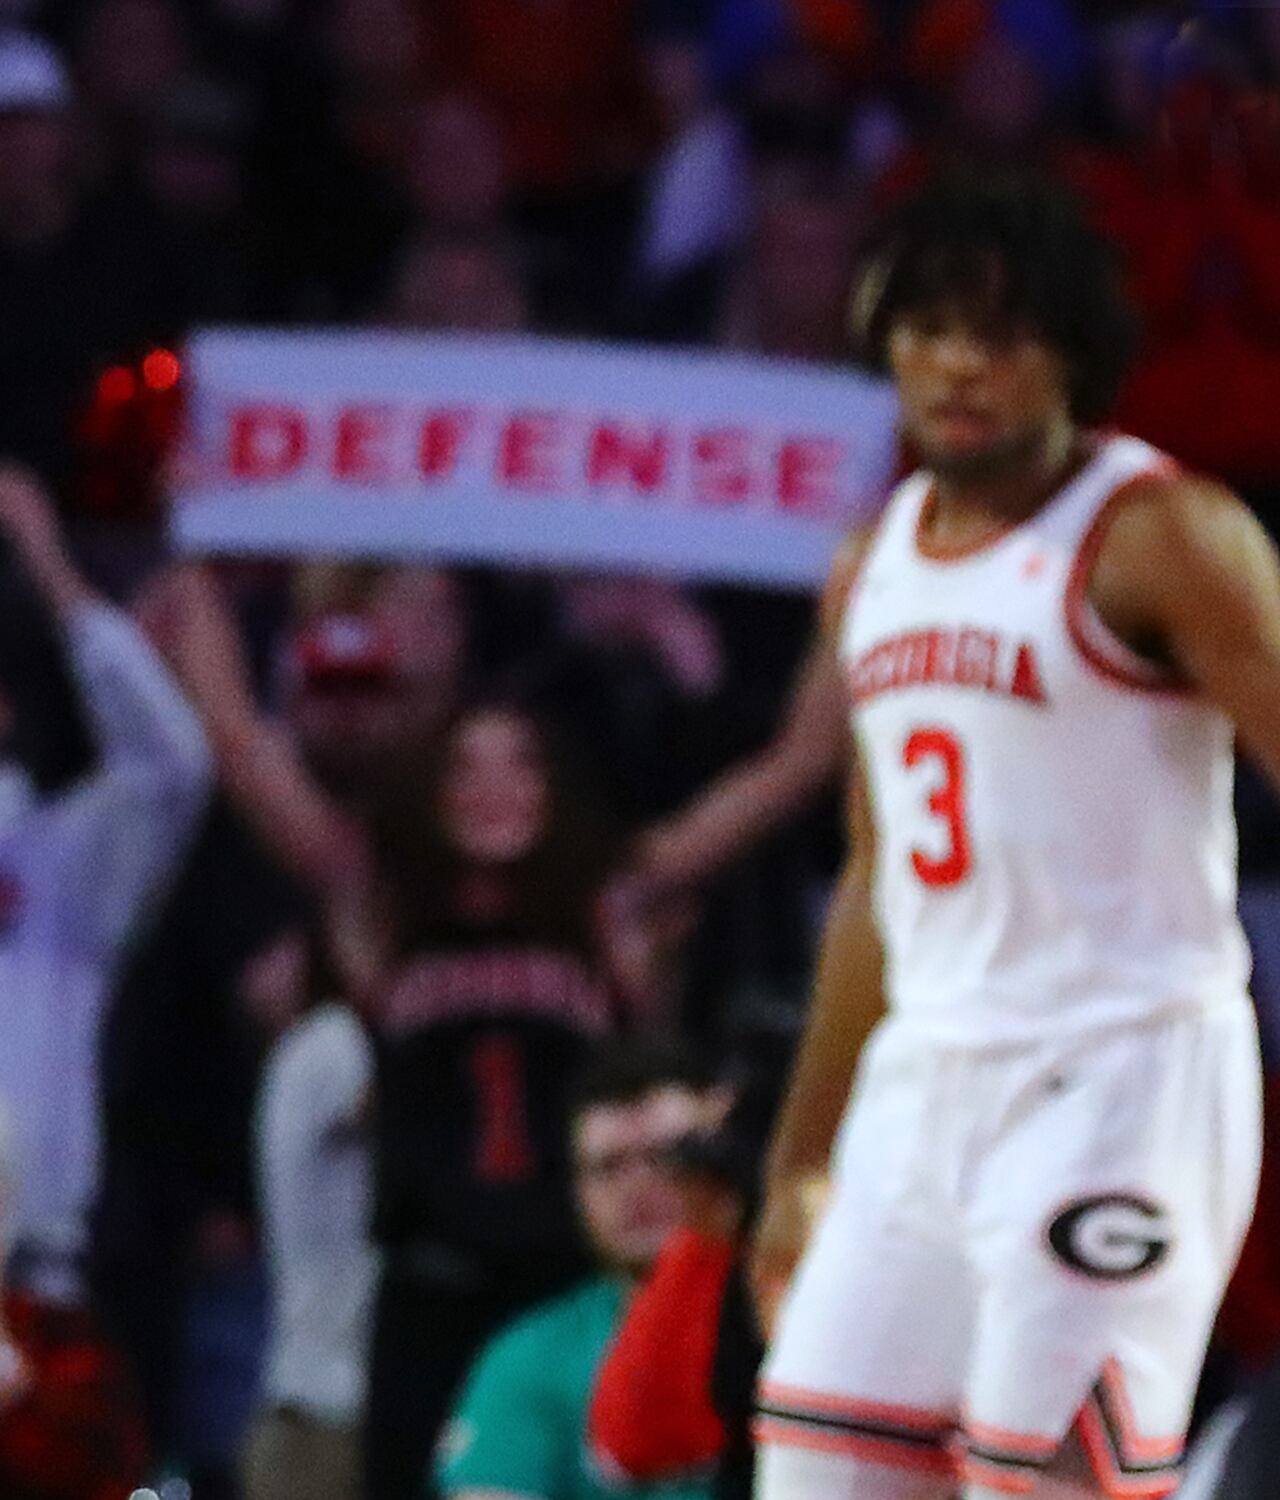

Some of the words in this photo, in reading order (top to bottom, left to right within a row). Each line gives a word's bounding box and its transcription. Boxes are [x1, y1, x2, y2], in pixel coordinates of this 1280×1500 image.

[227, 405, 842, 511] DEFENSE
[902, 727, 974, 887] 3
[1046, 1193, 1171, 1282] G
